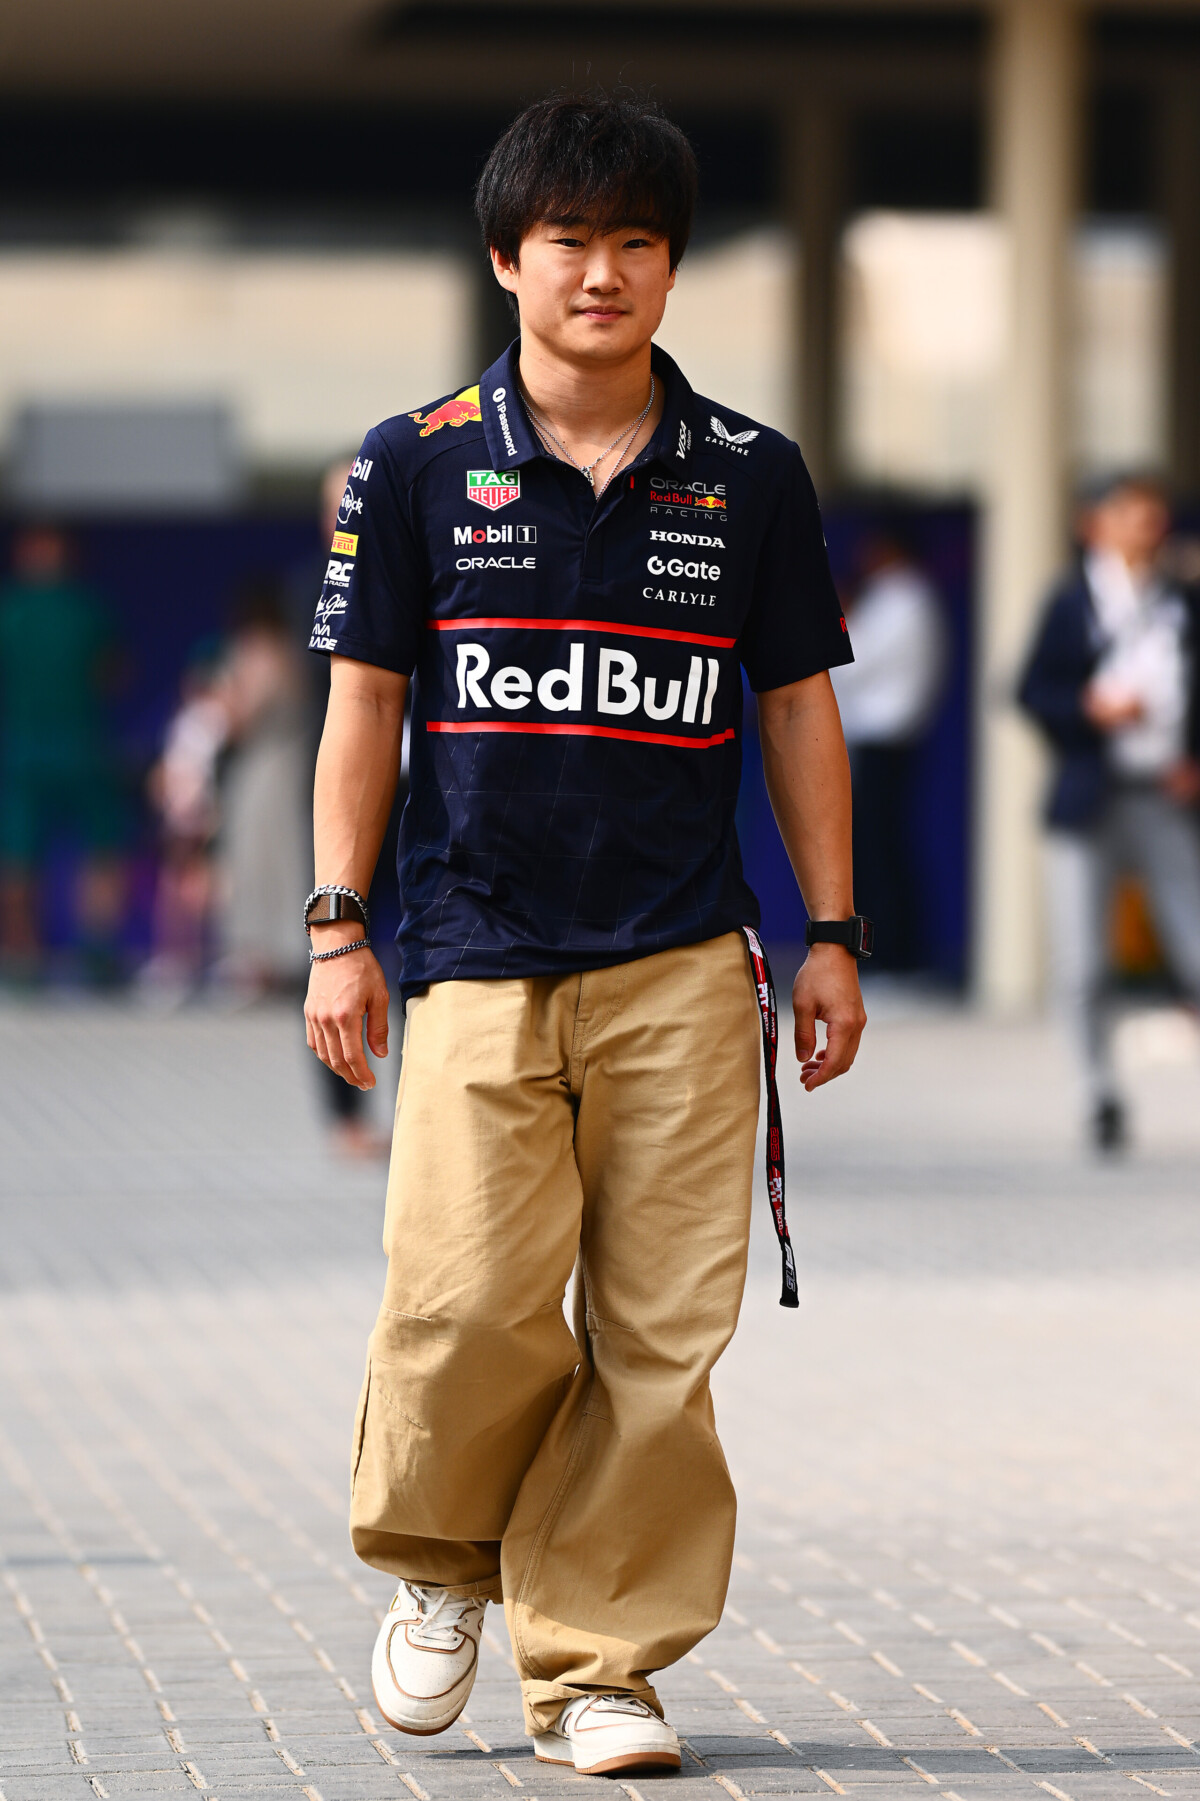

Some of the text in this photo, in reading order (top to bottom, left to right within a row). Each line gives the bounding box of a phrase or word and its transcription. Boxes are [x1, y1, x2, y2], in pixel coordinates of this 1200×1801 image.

[497, 402, 517, 457] 1Password
[676, 420, 687, 459] VISA
[705, 436, 749, 456] CASTORE
[349, 456, 373, 481] bil
[471, 473, 515, 485] TAG
[650, 477, 726, 495] ORACLE
[470, 488, 517, 507] HEUER
[650, 491, 692, 505] Red Bull
[650, 506, 727, 521] RACING
[453, 525, 512, 545] Mobil
[649, 530, 726, 549] HONDA
[456, 557, 536, 570] ORACLE
[667, 558, 721, 581] Gate
[642, 587, 717, 606] CARLYLE
[456, 643, 719, 724] Red Bull
[758, 982, 769, 1008] PIT
